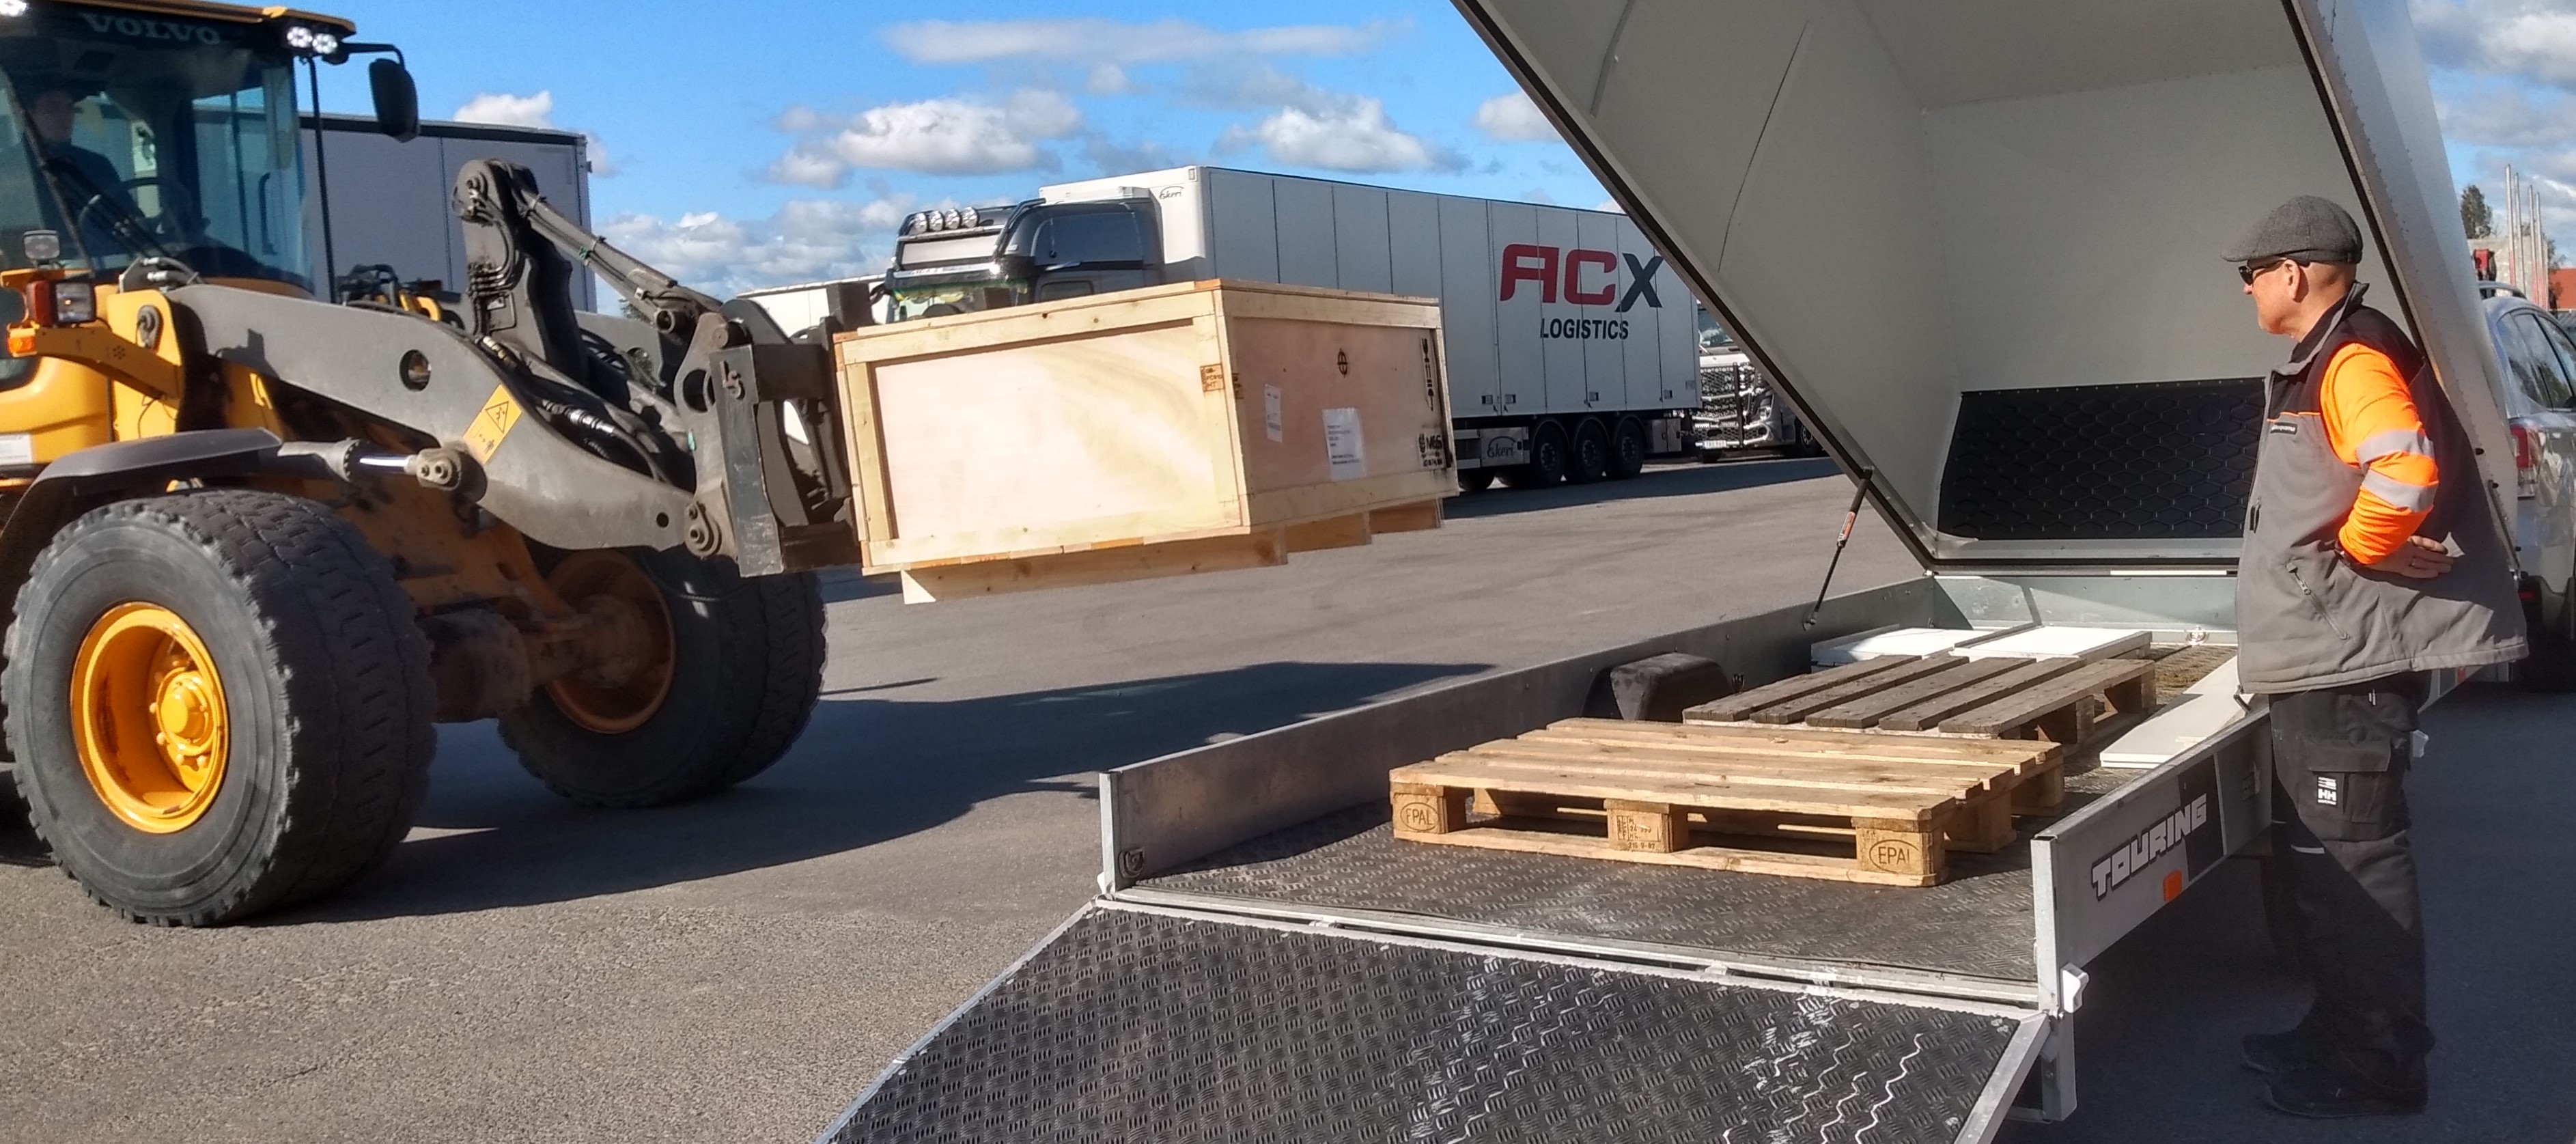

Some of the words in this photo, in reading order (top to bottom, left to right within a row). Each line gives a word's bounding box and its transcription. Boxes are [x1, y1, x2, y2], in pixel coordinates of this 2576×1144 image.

[79, 12, 221, 45] VOLVO
[1500, 243, 1665, 313] ACX
[1540, 318, 1629, 339] LOGISTICS
[2091, 793, 2207, 900] TOURING
